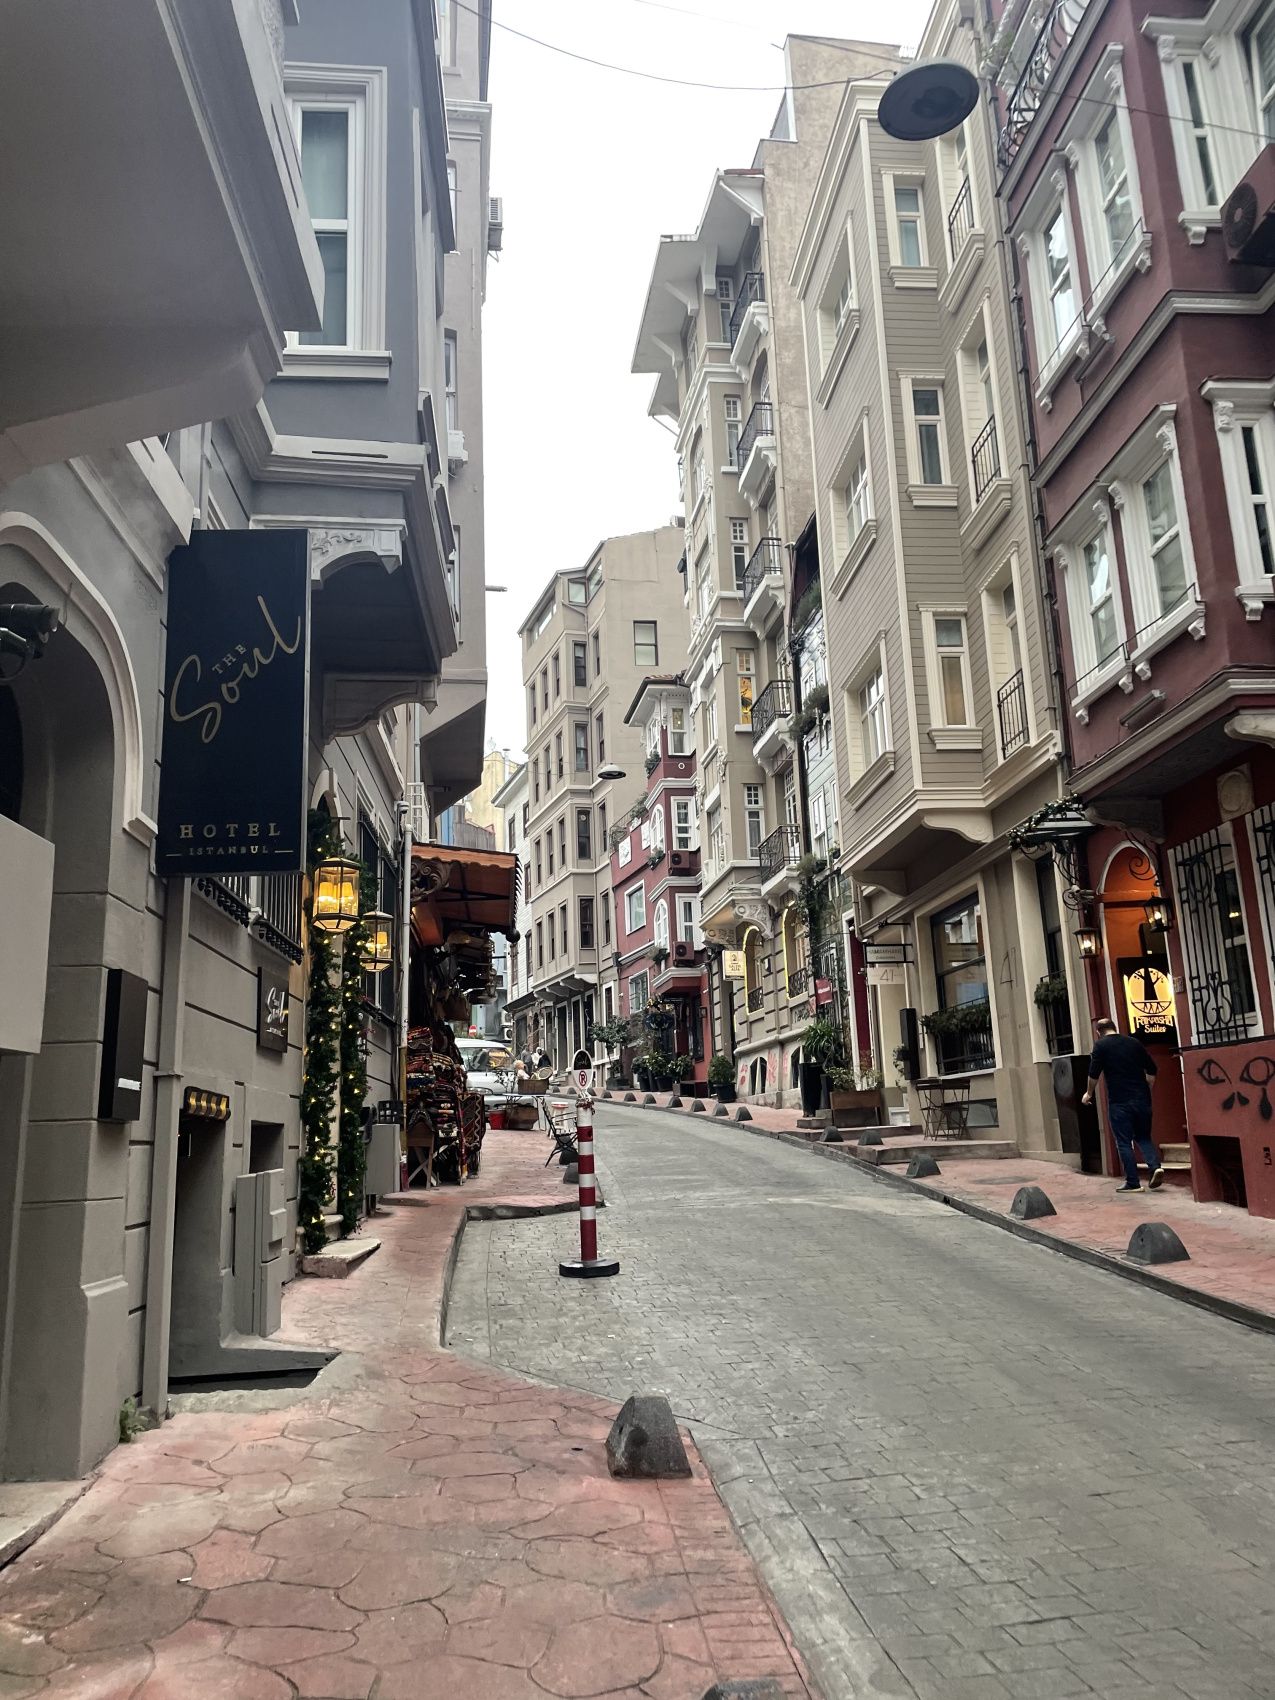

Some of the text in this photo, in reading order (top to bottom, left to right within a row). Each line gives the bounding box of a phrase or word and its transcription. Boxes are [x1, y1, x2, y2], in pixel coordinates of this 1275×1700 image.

[169, 594, 302, 744] Soul
[211, 643, 247, 675] THE
[179, 823, 281, 839] HOTEL
[188, 845, 269, 856] ISTANBUL
[880, 968, 894, 983] 41
[1000, 947, 1018, 990] 41
